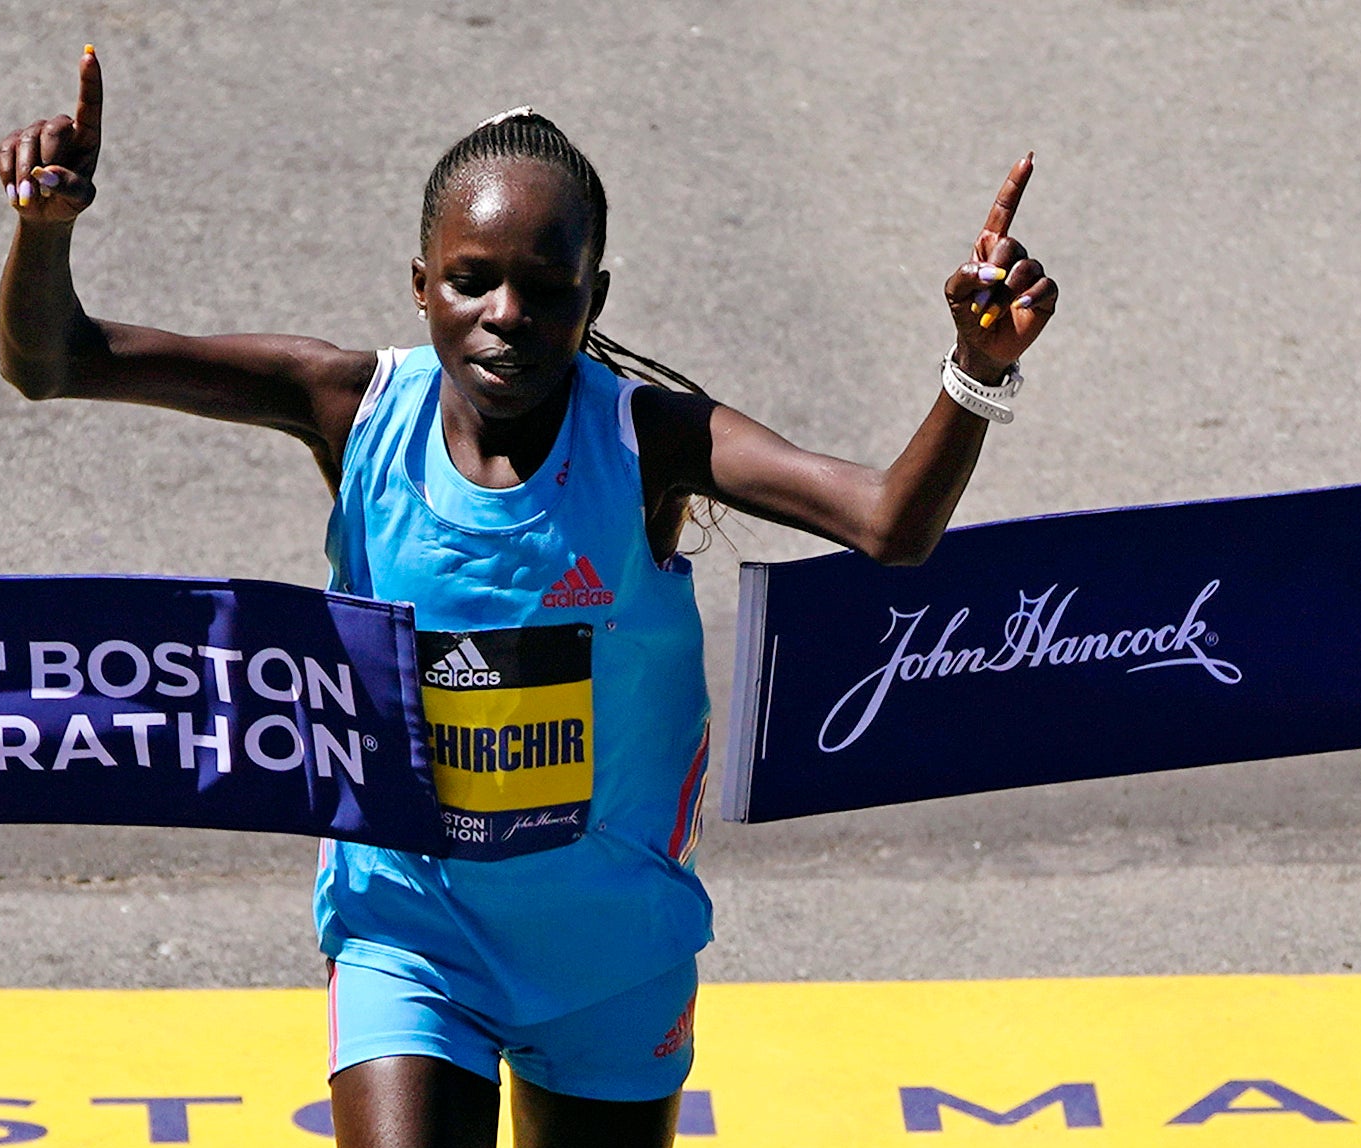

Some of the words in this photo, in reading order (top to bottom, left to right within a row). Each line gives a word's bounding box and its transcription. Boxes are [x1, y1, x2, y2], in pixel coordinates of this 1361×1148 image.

[541, 589, 615, 608] adidas
[29, 640, 356, 718] BOSTON
[425, 668, 501, 688] adidas
[818, 604, 985, 753] John
[440, 812, 485, 830] STON
